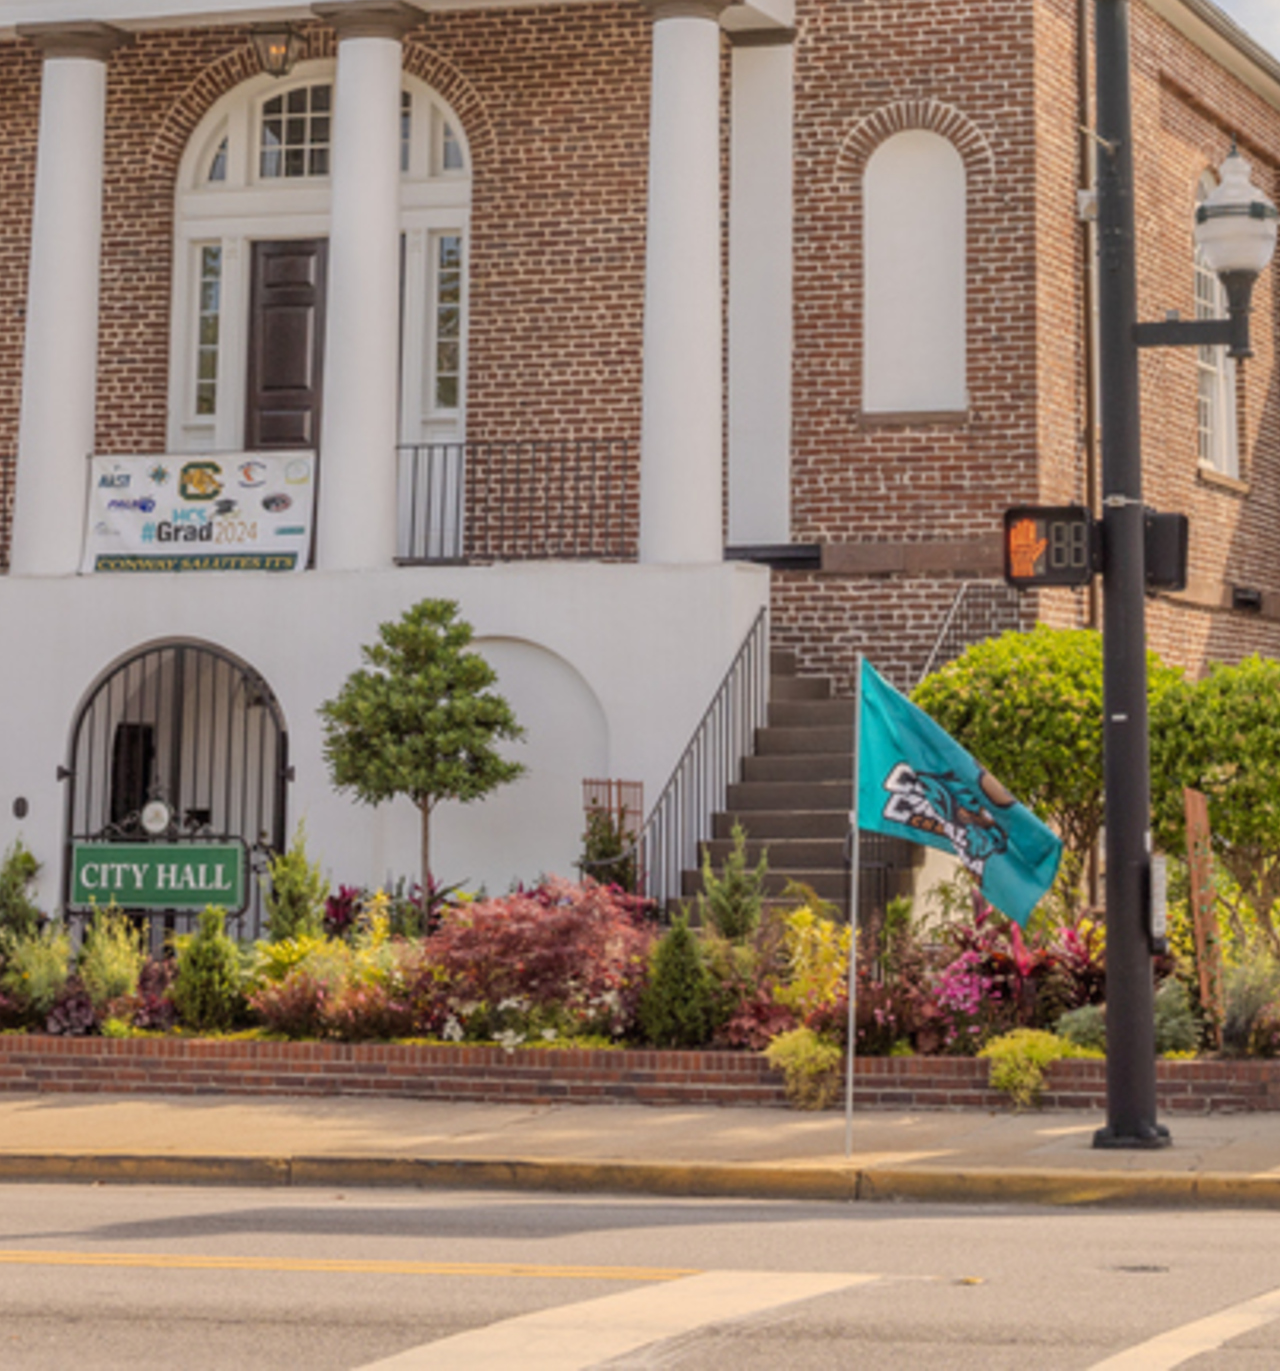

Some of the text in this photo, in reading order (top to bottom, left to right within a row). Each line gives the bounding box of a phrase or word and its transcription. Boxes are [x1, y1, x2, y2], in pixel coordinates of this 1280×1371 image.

[140, 521, 213, 544] #Grad
[214, 521, 258, 544] 2024
[97, 557, 177, 571] CONWAY
[180, 556, 260, 570] SALUTES
[80, 862, 232, 890] CITY HALL
